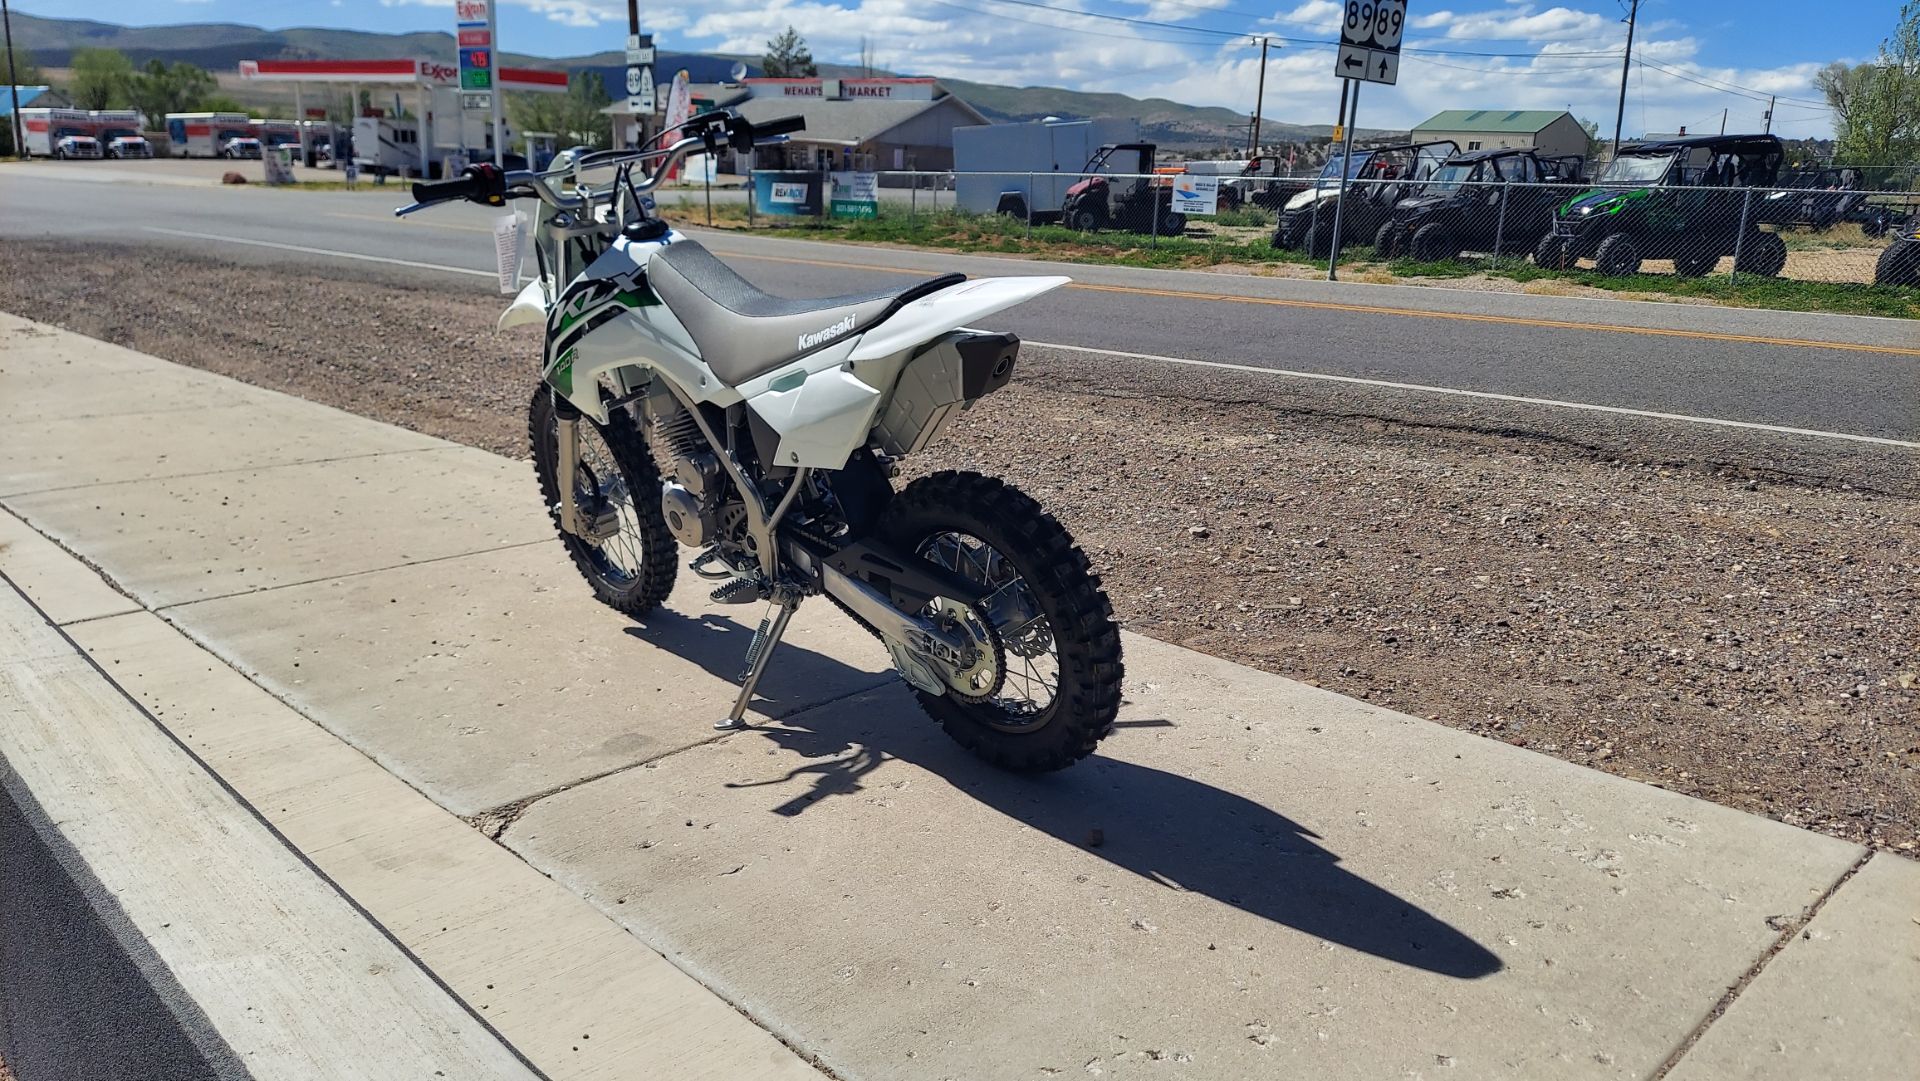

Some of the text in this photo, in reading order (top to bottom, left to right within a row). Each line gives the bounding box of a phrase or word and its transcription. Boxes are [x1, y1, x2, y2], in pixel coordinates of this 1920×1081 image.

[458, 1, 486, 19] Exxon
[1347, 1, 1373, 31] 89
[1377, 8, 1402, 37] 89
[629, 73, 640, 87] 89
[848, 87, 892, 97] MARKET
[798, 313, 857, 351] Kawasaki
